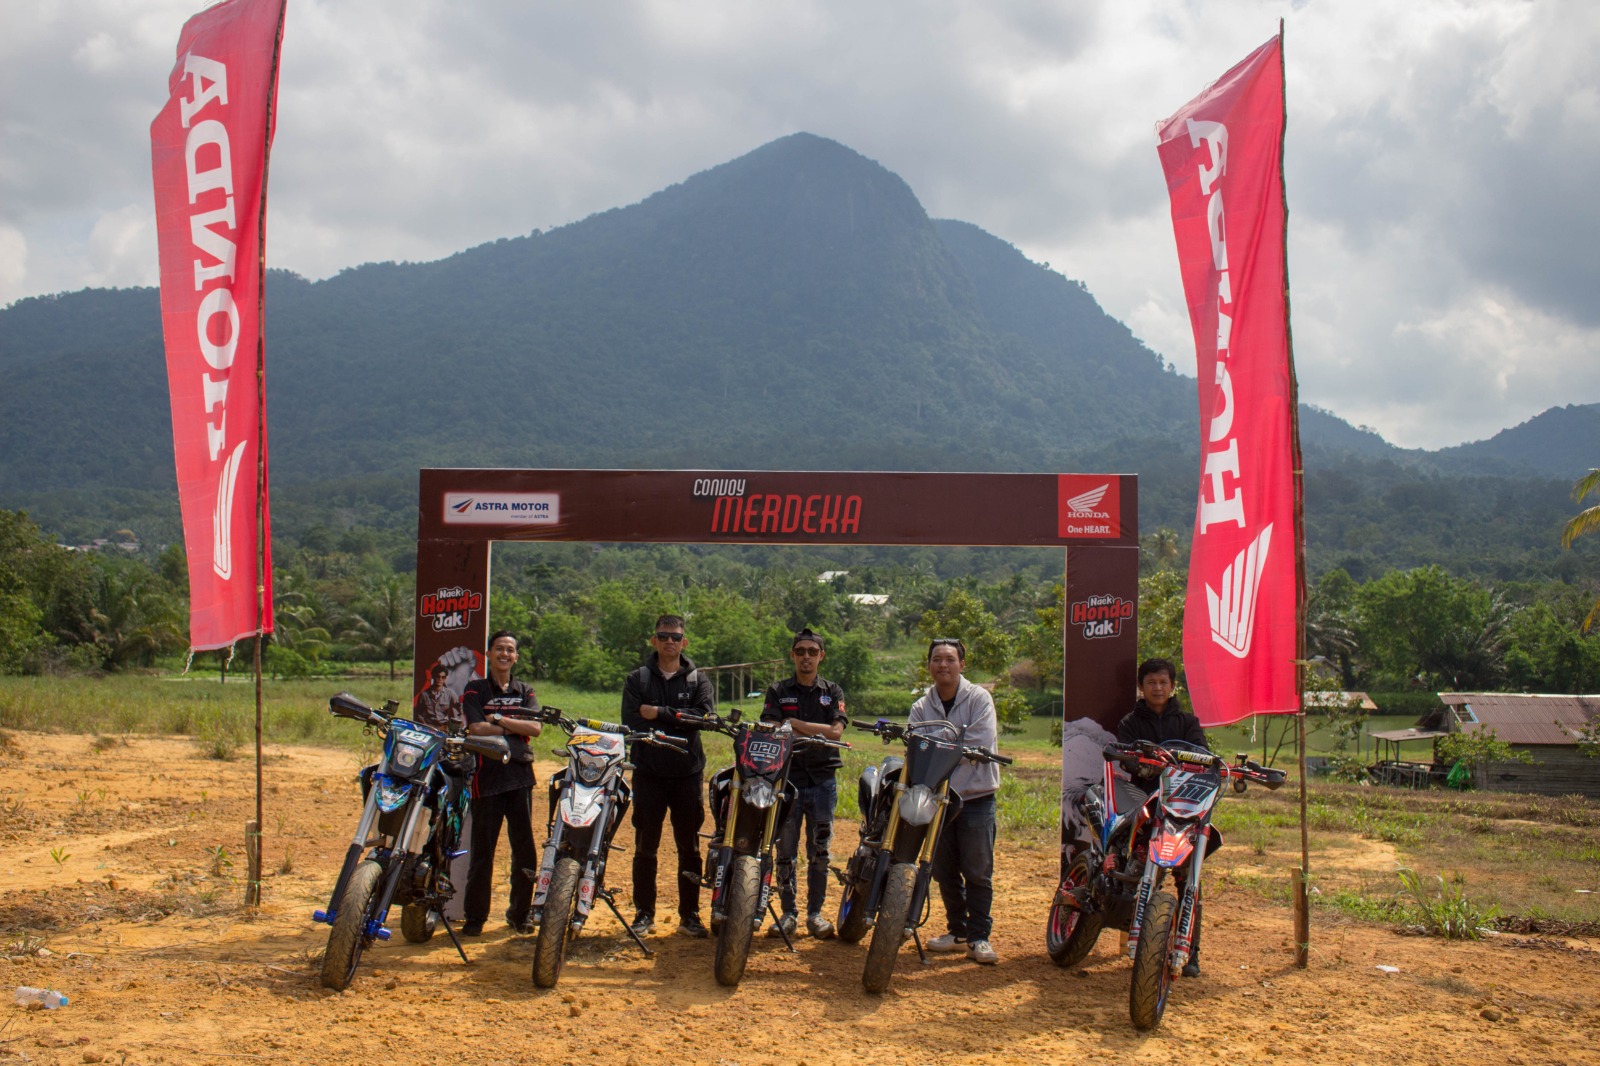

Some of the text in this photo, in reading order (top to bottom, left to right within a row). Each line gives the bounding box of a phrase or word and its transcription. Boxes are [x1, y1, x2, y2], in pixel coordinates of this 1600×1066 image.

[693, 478, 746, 496] CONVOY
[475, 502, 549, 511] ASTRA MOTOR
[710, 494, 863, 534] MERDEKA
[1067, 511, 1110, 519] HONDA
[1067, 525, 1111, 534] One HEART.
[440, 588, 461, 599] Naek
[1090, 595, 1112, 606] Naek
[422, 591, 480, 615] Honda
[1073, 600, 1131, 622] Honda
[435, 610, 468, 629] Jak!
[1085, 619, 1119, 637] Jak!
[749, 741, 781, 757] 020
[715, 865, 724, 888] BOLD
[761, 884, 770, 908] BOLD
